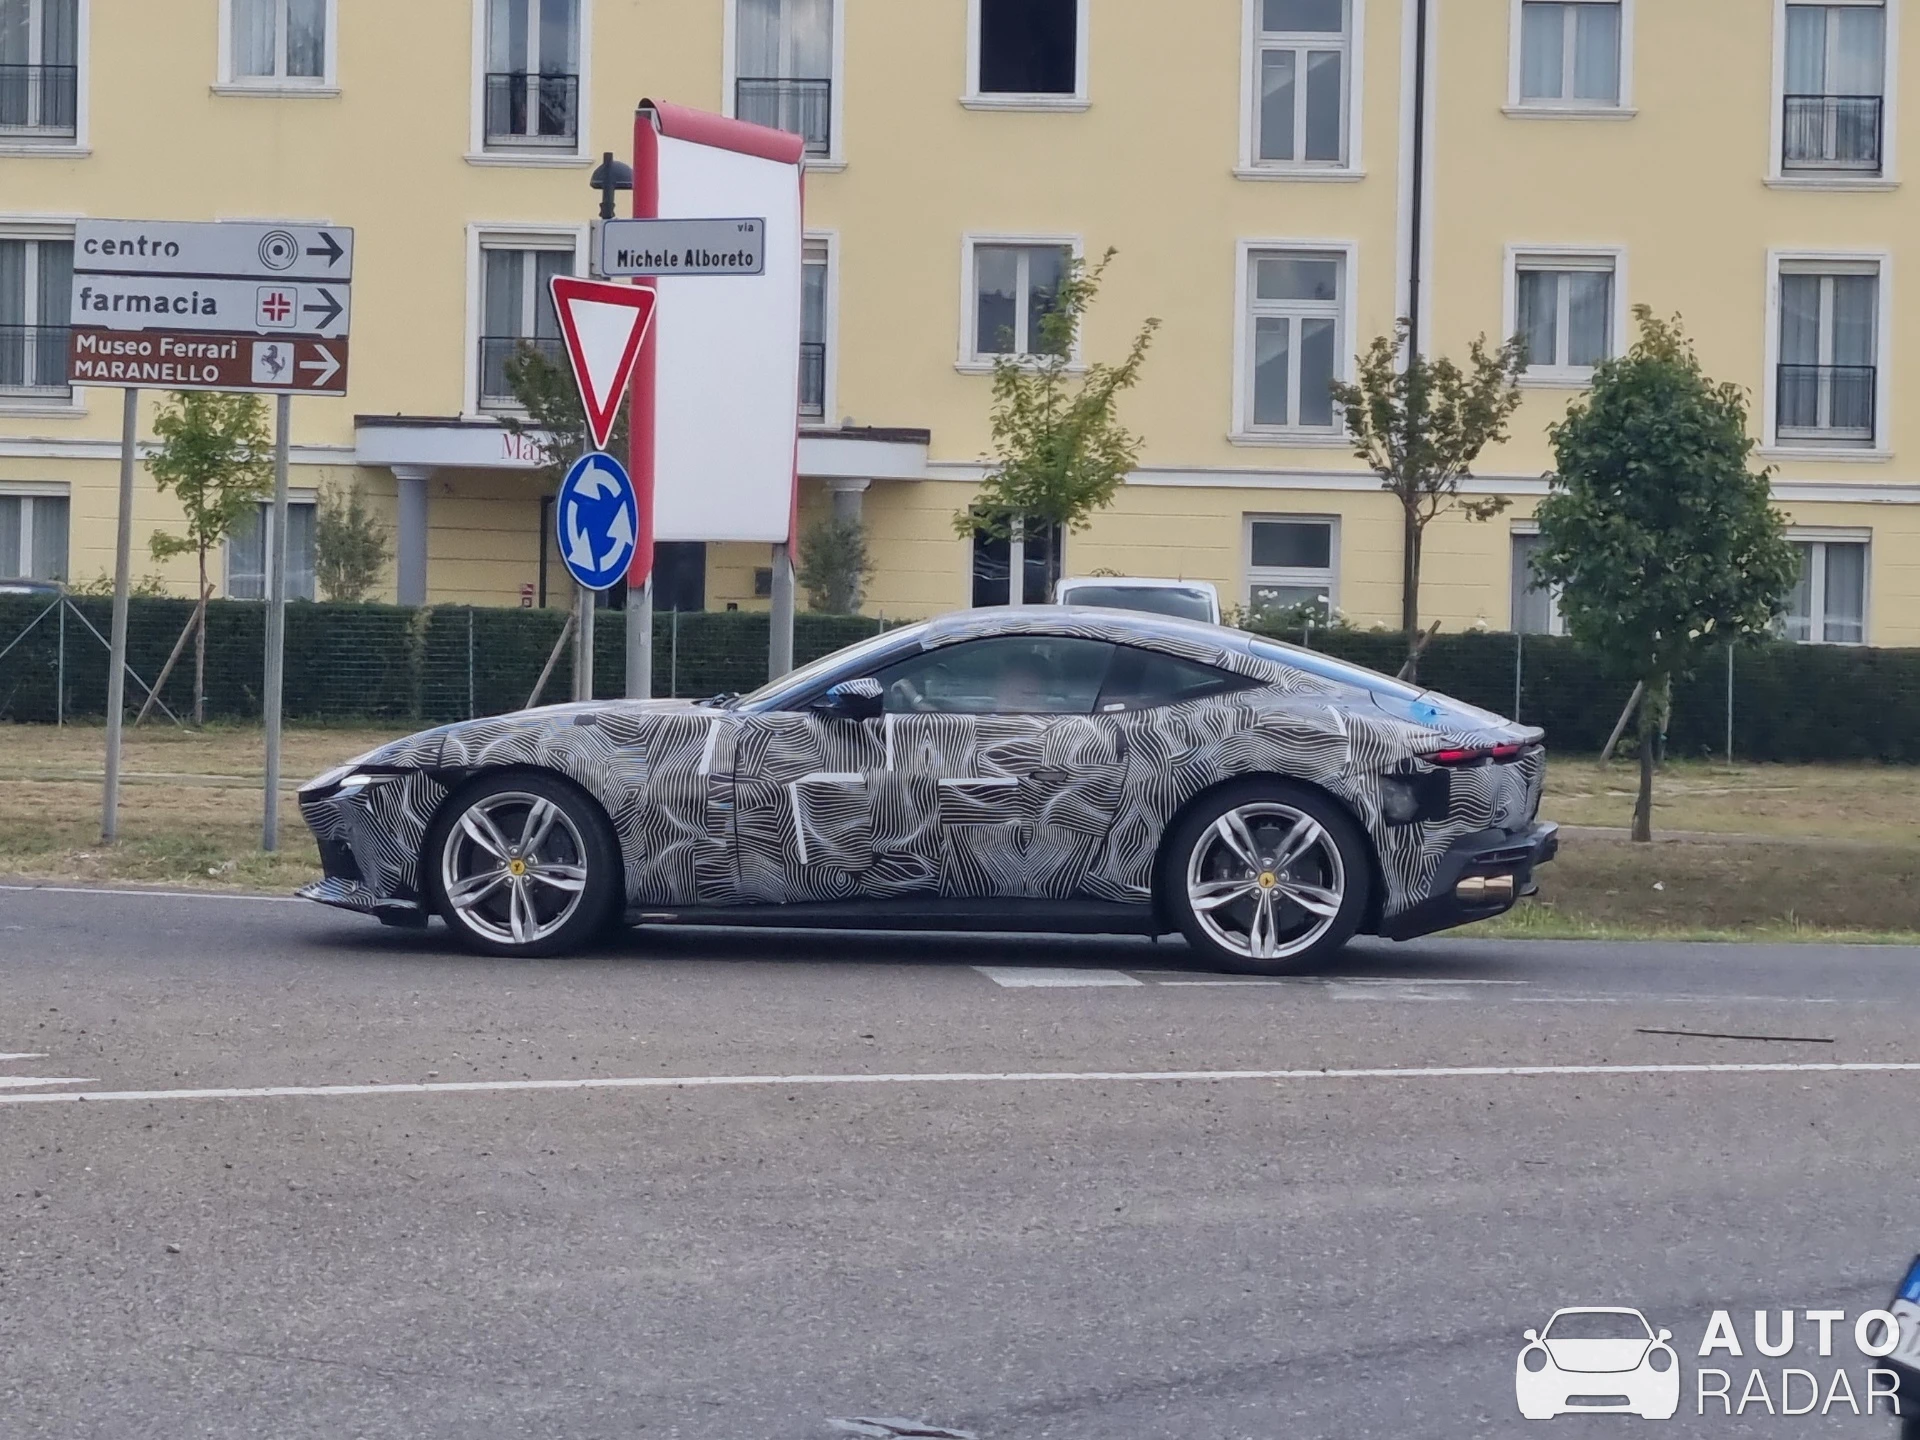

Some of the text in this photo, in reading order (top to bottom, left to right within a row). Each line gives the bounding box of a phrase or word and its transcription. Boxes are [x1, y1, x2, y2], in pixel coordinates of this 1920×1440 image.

[737, 223, 754, 232] via
[84, 235, 180, 257] centro
[617, 249, 753, 268] Michele Alboreto
[80, 287, 217, 315] farmacia
[76, 335, 237, 359] Museo Ferrari
[75, 360, 219, 382] MARANELLO
